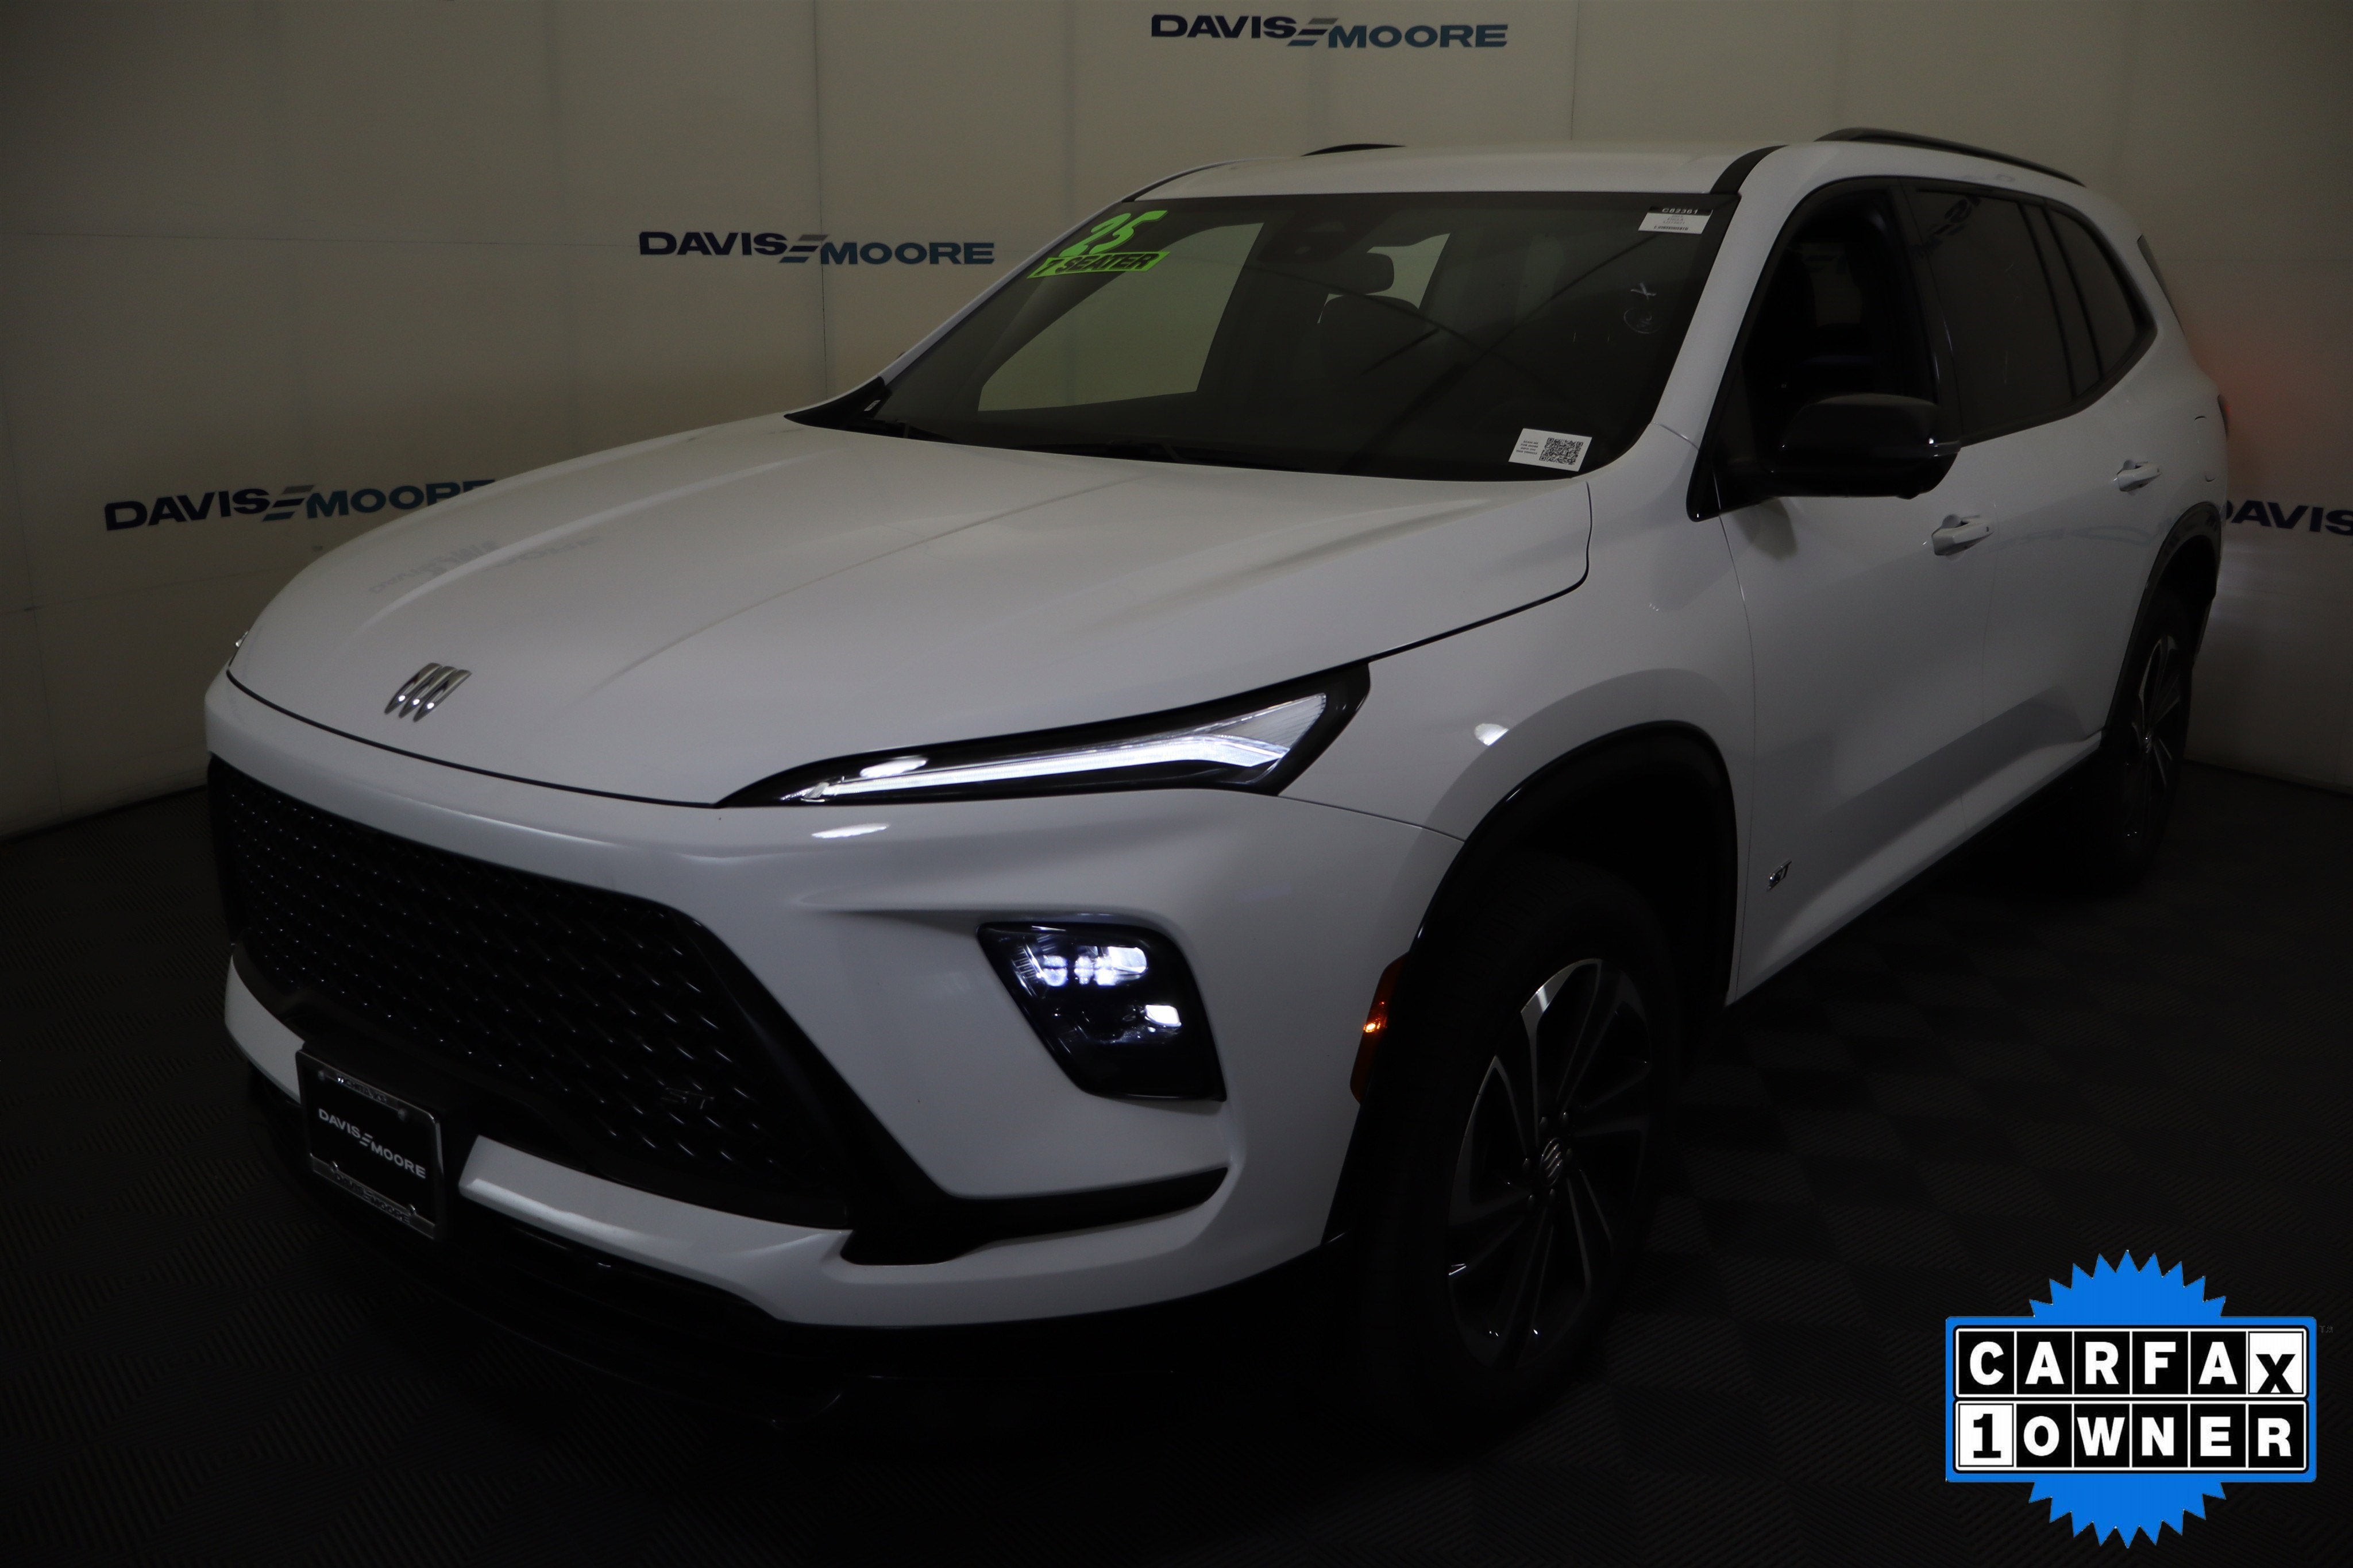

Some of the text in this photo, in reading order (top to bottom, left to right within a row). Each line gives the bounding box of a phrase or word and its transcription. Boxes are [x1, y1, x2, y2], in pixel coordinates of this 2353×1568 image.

[1151, 14, 1508, 48] DAVIS MOORE
[639, 231, 994, 264] DAVIS MOORE
[1058, 210, 1168, 258] 25
[1055, 253, 1161, 273] SEATER
[104, 479, 496, 531] DAVIS MOOR
[2226, 500, 2353, 536] AVIS
[318, 1107, 427, 1179] DAVIS MOORE
